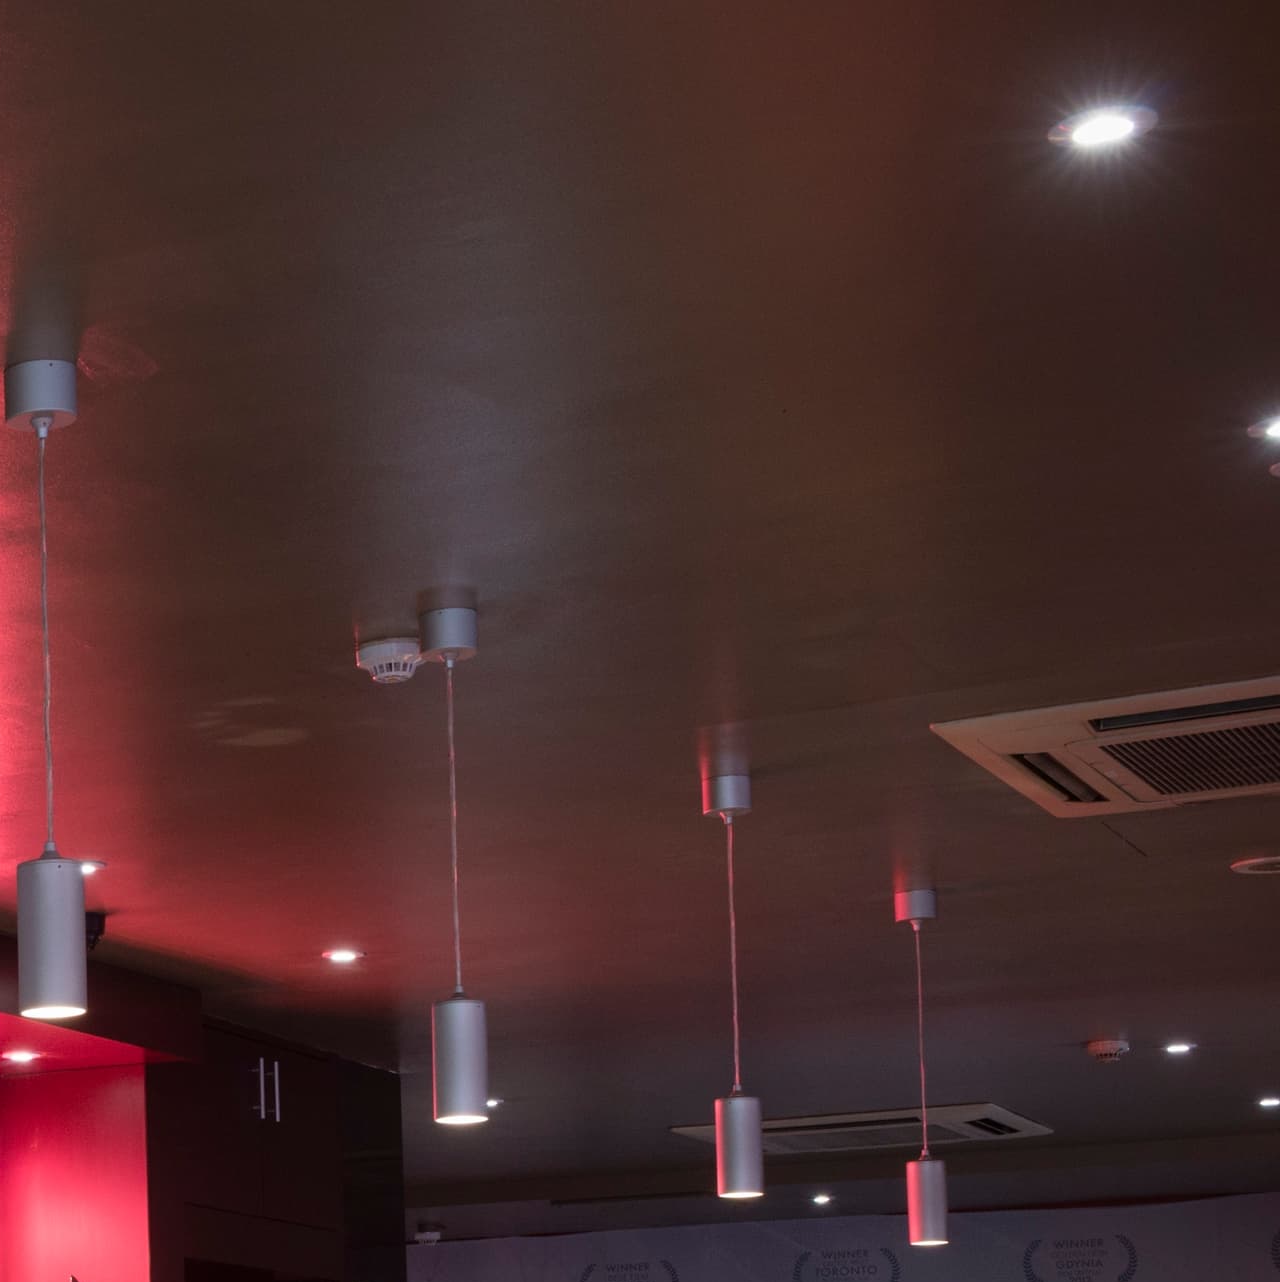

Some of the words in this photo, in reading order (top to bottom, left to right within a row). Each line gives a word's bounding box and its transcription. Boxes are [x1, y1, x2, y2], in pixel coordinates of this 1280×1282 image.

[1054, 1238, 1104, 1248] WINNER
[821, 1248, 869, 1259] WINNER
[606, 1263, 649, 1272] WINNER
[1056, 1258, 1104, 1269] GDYNIA
[816, 1264, 878, 1278] TORONTO
